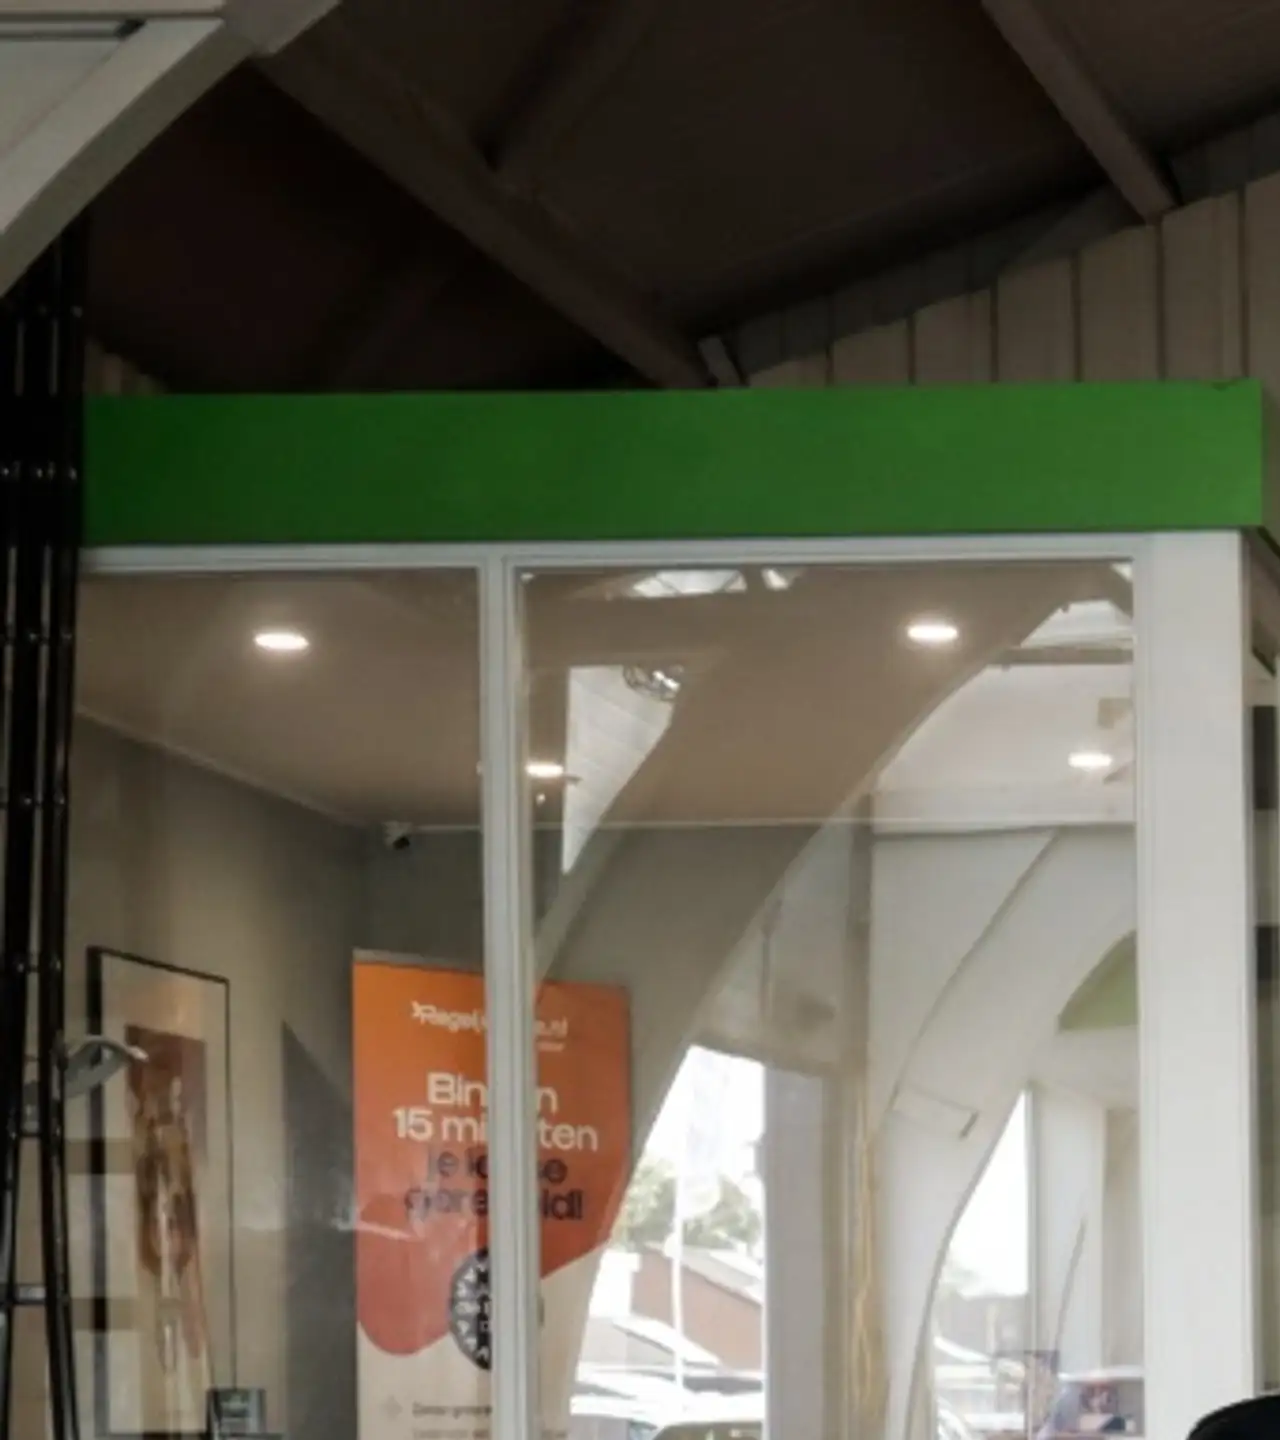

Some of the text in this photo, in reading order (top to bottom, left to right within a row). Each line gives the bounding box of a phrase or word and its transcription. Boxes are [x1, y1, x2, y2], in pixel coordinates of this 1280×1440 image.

[427, 1072, 558, 1113] Binn
[393, 1107, 598, 1151] 15 miten
